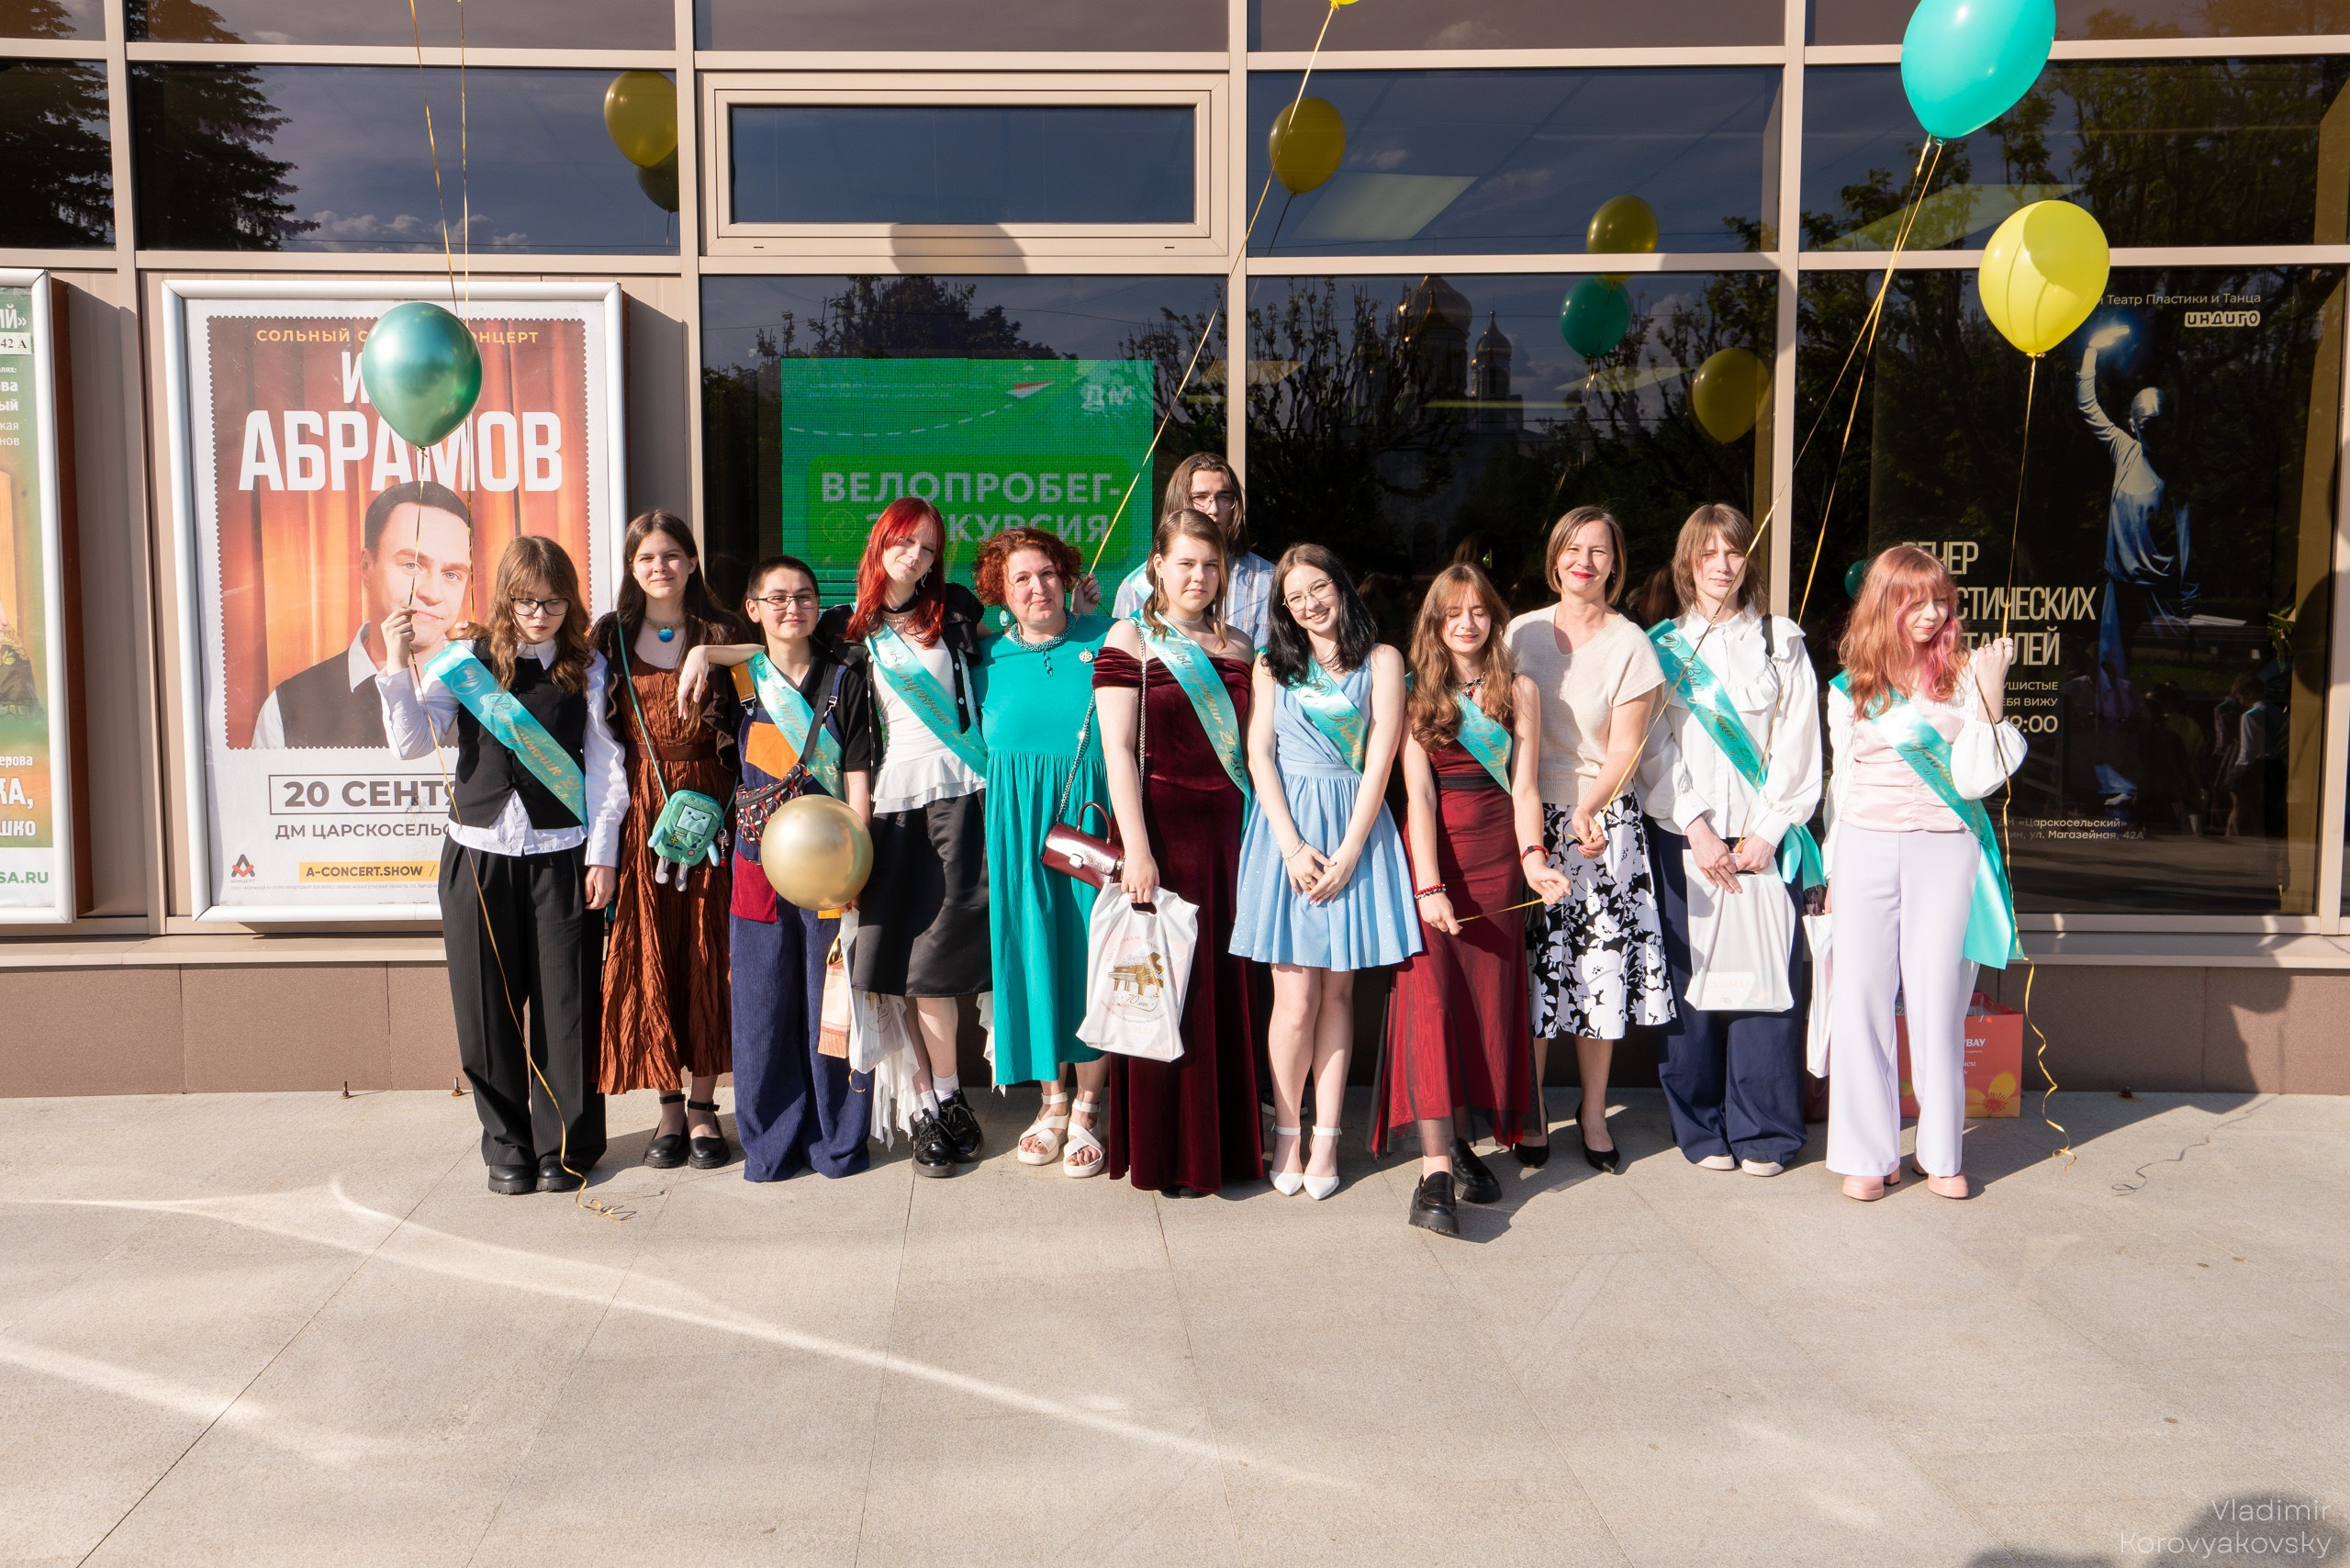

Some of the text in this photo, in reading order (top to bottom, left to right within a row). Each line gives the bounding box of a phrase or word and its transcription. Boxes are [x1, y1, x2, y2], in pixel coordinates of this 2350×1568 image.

[2107, 295, 2143, 307] Театр
[2146, 294, 2207, 305] Пластики
[2211, 295, 2220, 304] и
[2222, 293, 2261, 305] Танца
[0, 338, 14, 348] 42
[255, 328, 351, 343] СОЛЬНЫЙ
[471, 330, 539, 346] НЦЕРТ
[0, 381, 18, 392] ва
[0, 421, 19, 431] кая
[0, 437, 20, 446] нов
[239, 409, 563, 491] АБРАМОВ
[822, 471, 1121, 504] ВЕЛОПРОБЕГ-
[1902, 541, 1979, 576] ЧЕР
[1957, 586, 2097, 621] СТИЧЕСКИХ
[2003, 681, 2059, 690] УШИСТЫЕ
[2003, 698, 2058, 707] ЕБЯ ВИЖУ
[2003, 714, 2059, 734] 9:00
[0, 756, 33, 767] ерова
[283, 781, 330, 808] 20
[0, 820, 37, 836] шко
[2019, 818, 2128, 829] «Царскосельский»
[275, 823, 308, 841] ДМ
[2048, 829, 2120, 841] Магазейная,
[0, 871, 49, 884] SA.RU
[306, 865, 423, 878] A-CONCERT.SHOW
[1964, 1037, 1986, 1047] BAY
